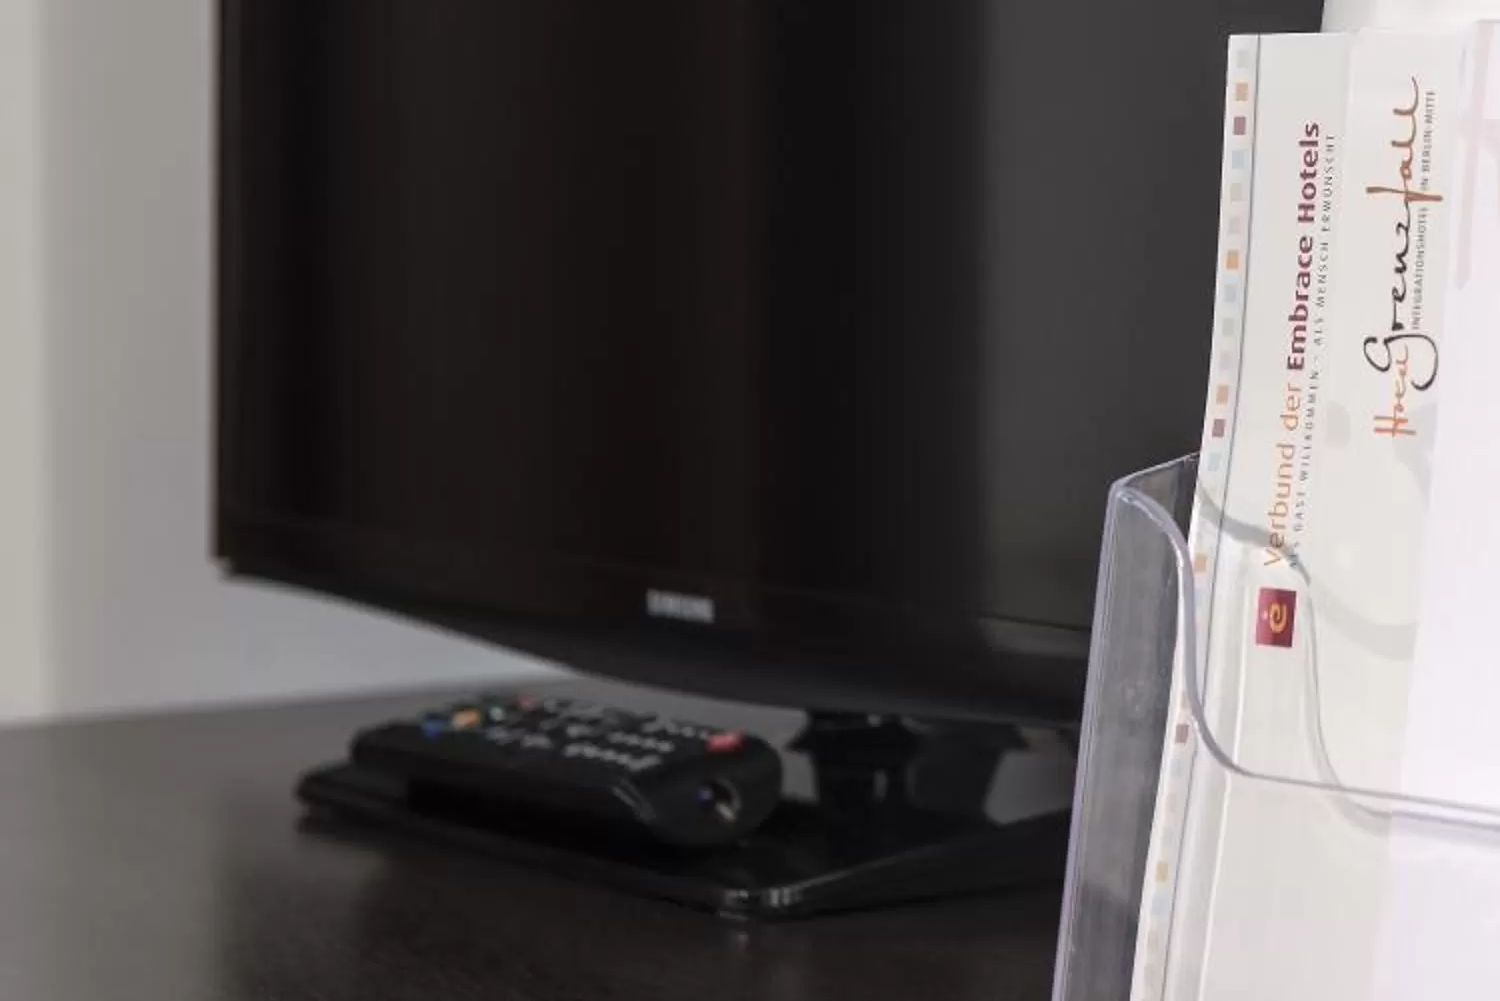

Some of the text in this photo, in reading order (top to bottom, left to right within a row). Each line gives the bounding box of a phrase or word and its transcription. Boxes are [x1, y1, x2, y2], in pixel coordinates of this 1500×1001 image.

[1264, 122, 1320, 567] Verbund der Embrace Hotels
[1316, 242, 1329, 309] MENSCH
[1363, 75, 1444, 392] Grenzfall
